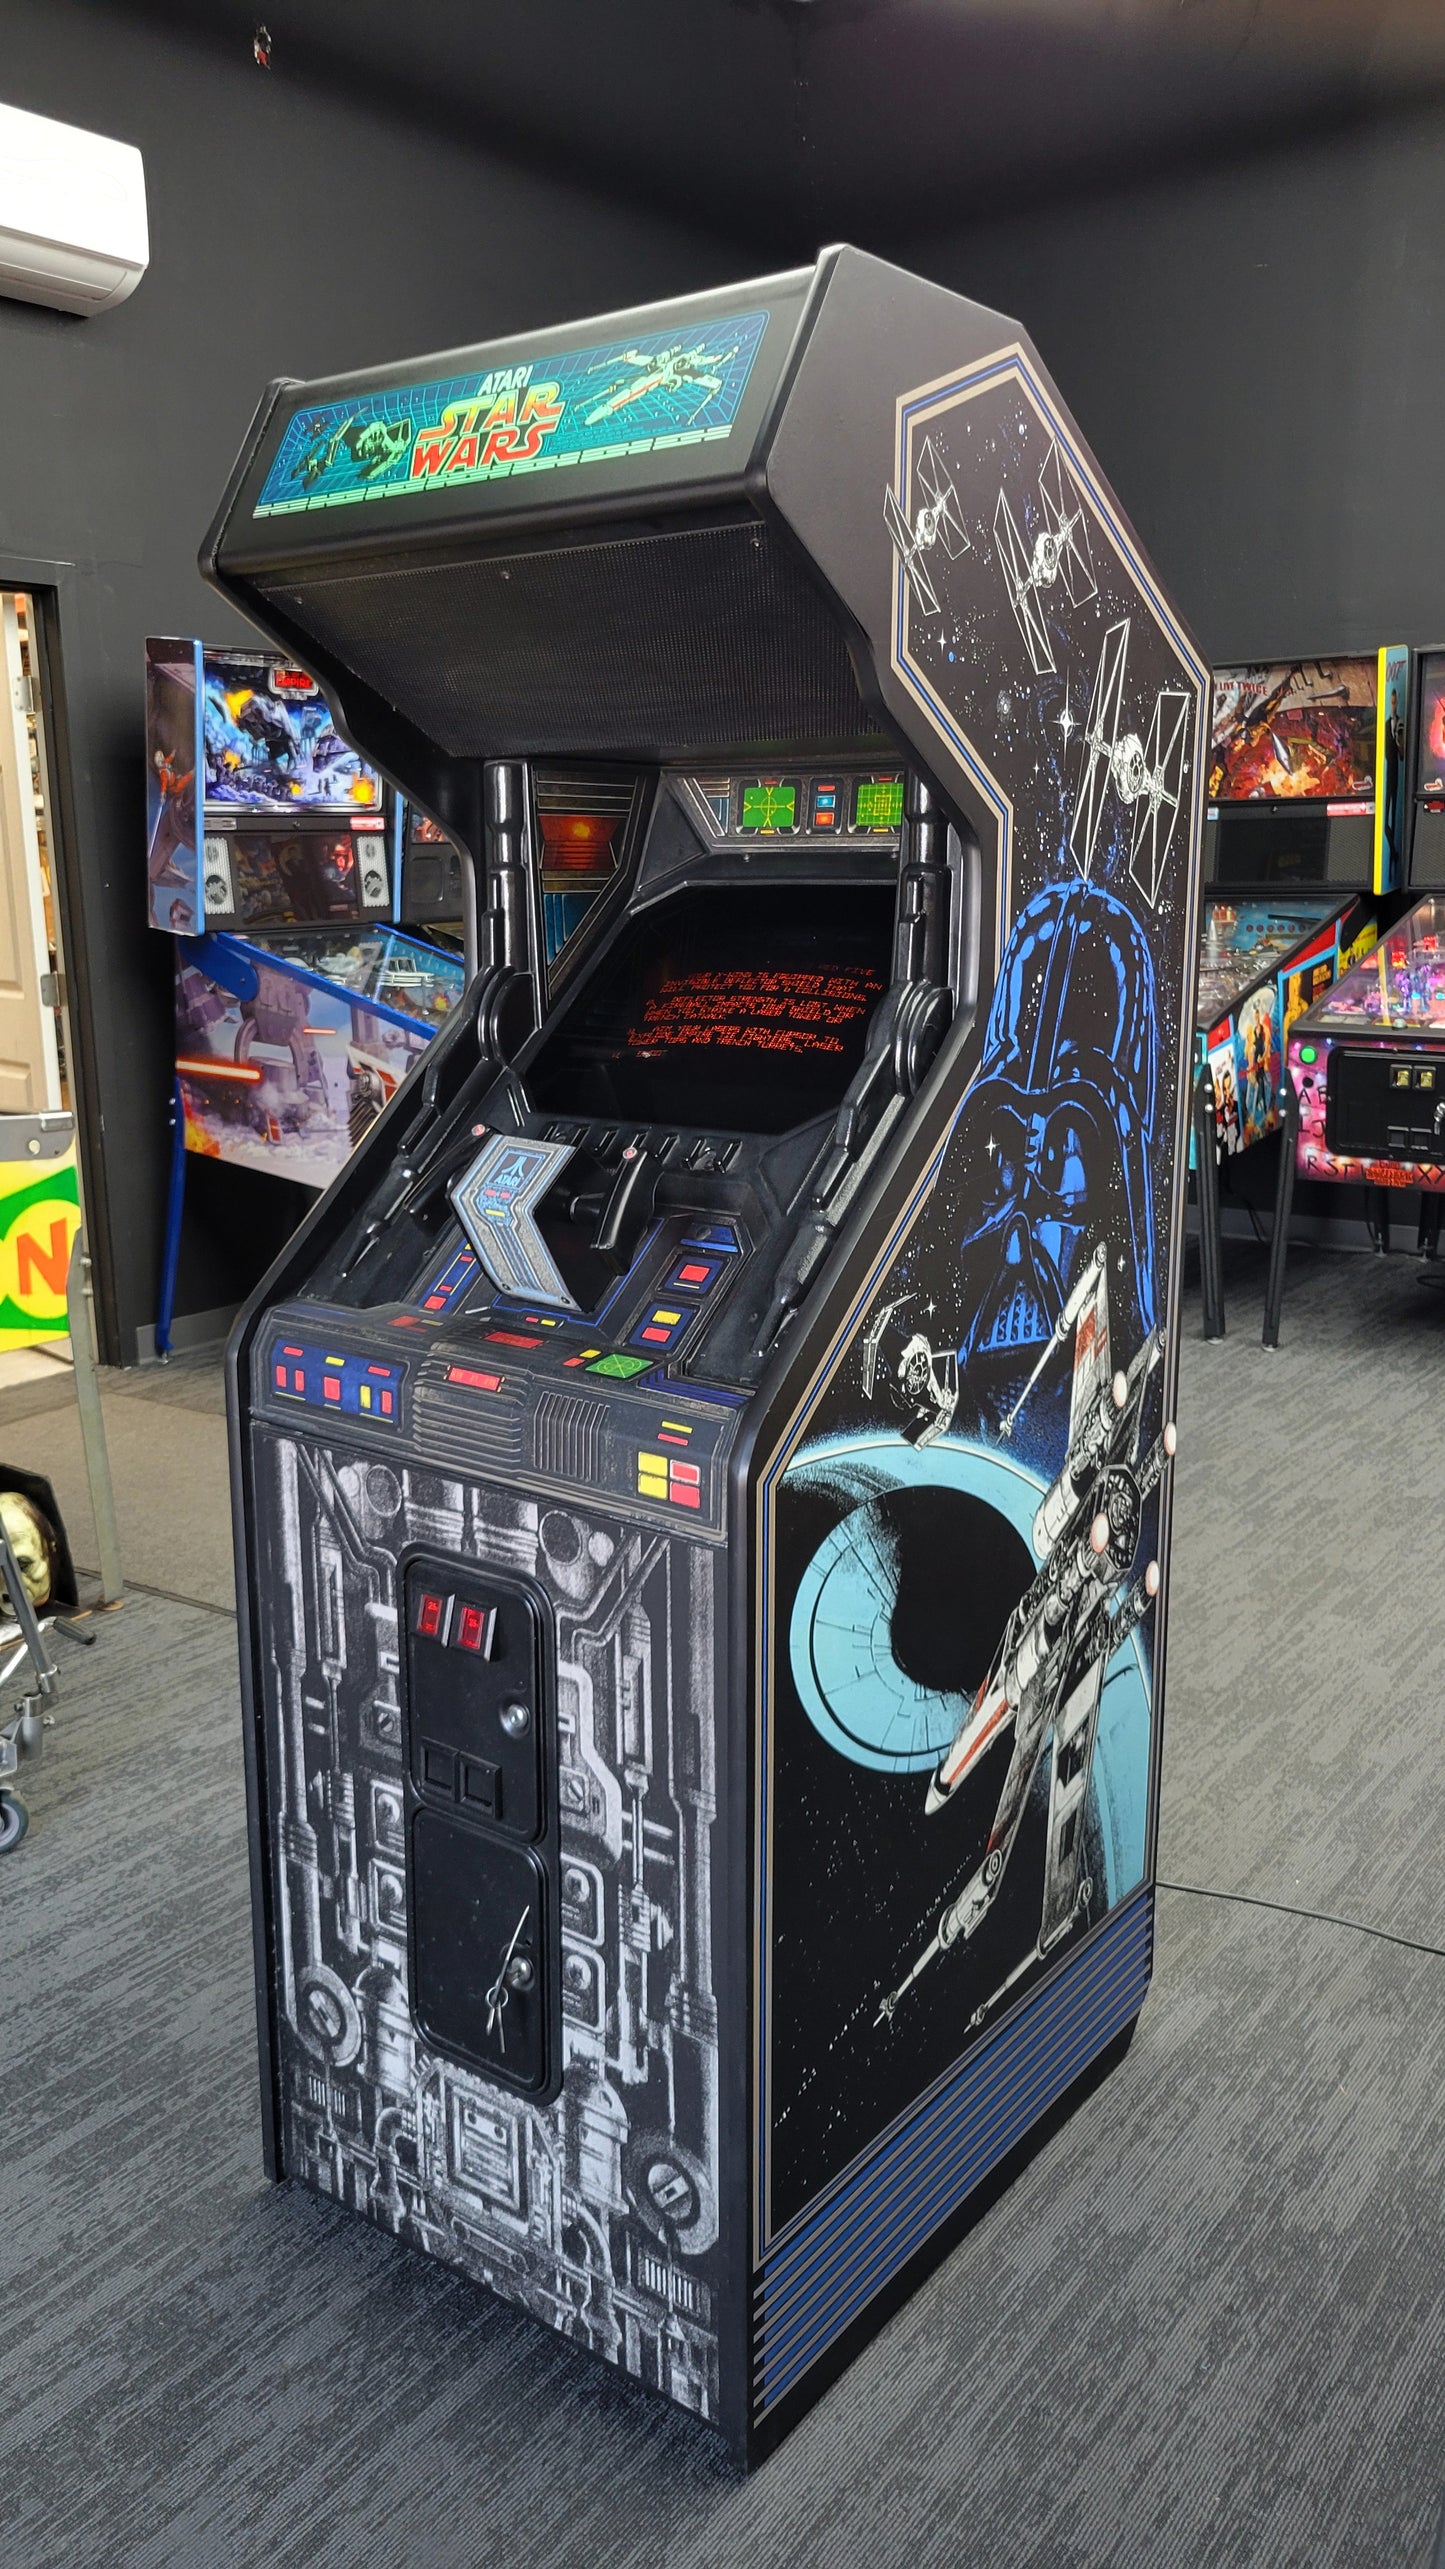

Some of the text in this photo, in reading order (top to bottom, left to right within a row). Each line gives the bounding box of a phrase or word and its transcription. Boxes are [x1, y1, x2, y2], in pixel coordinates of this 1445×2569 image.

[477, 364, 534, 397] ATARI
[416, 381, 567, 442] STAR
[409, 420, 561, 479] WARS
[1220, 681, 1235, 691] LIVE
[1237, 681, 1268, 696] TWICE
[760, 984, 780, 992] FOR
[827, 977, 860, 987] WITH
[864, 981, 883, 991] AN
[800, 999, 829, 1008] LOST
[833, 1003, 867, 1016] WHEN
[837, 1010, 856, 1020] OR
[750, 1009, 783, 1018] LASER
[788, 1013, 821, 1022] TOWER
[825, 1015, 844, 1025] OR
[744, 1026, 771, 1036] WITH
[774, 1029, 817, 1041] CURSOR
[825, 1035, 840, 1045] TO
[757, 1040, 804, 1054] TURRETS.
[803, 1040, 844, 1052] LASER
[494, 1175, 522, 1187] ATARI
